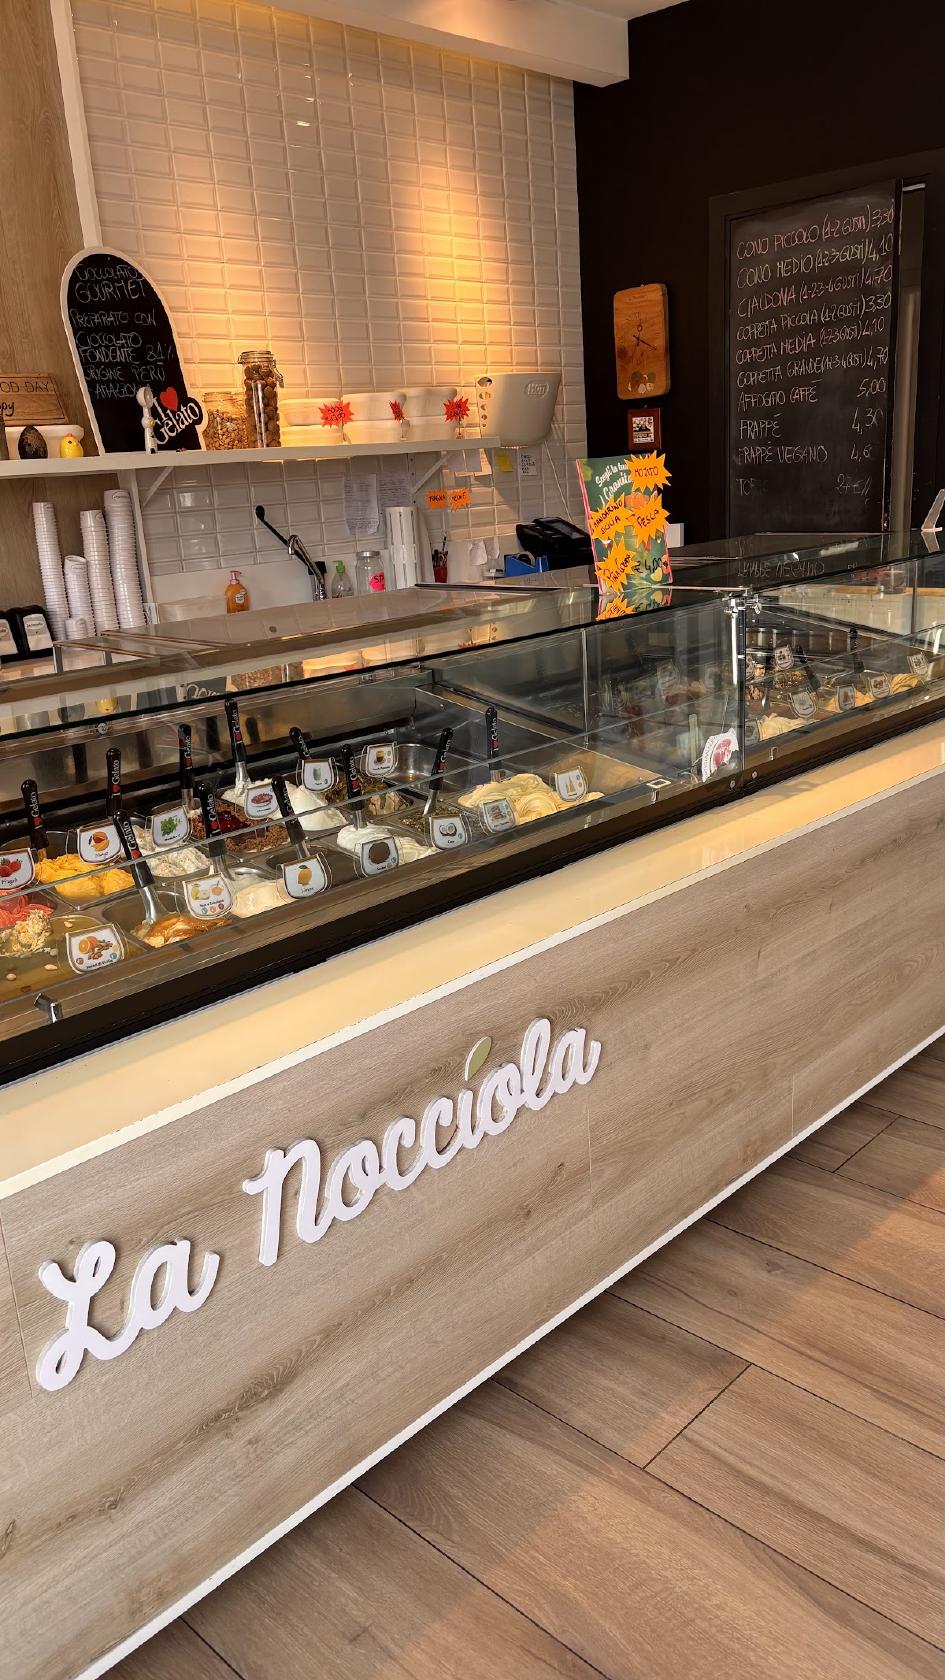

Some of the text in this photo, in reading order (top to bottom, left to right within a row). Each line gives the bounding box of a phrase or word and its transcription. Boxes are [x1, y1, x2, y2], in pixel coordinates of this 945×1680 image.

[737, 236, 769, 260] CONO
[774, 224, 819, 249] PICCOLO
[737, 267, 771, 289] CONO
[74, 279, 146, 303] GOURMET
[737, 286, 796, 317] CIALDONA
[69, 308, 156, 328] PREPARATO CON
[80, 346, 140, 364] FONDENTE
[24, 381, 50, 393] DAY
[154, 402, 200, 445] Gelato
[777, 444, 829, 464] VEGANO
[636, 508, 660, 529] PESCA
[111, 760, 120, 785] Gelato
[30, 792, 40, 818] Gelato
[207, 793, 219, 821] Gelato
[123, 821, 137, 850] Gelato
[36, 1017, 601, 1391] La Nocciola
